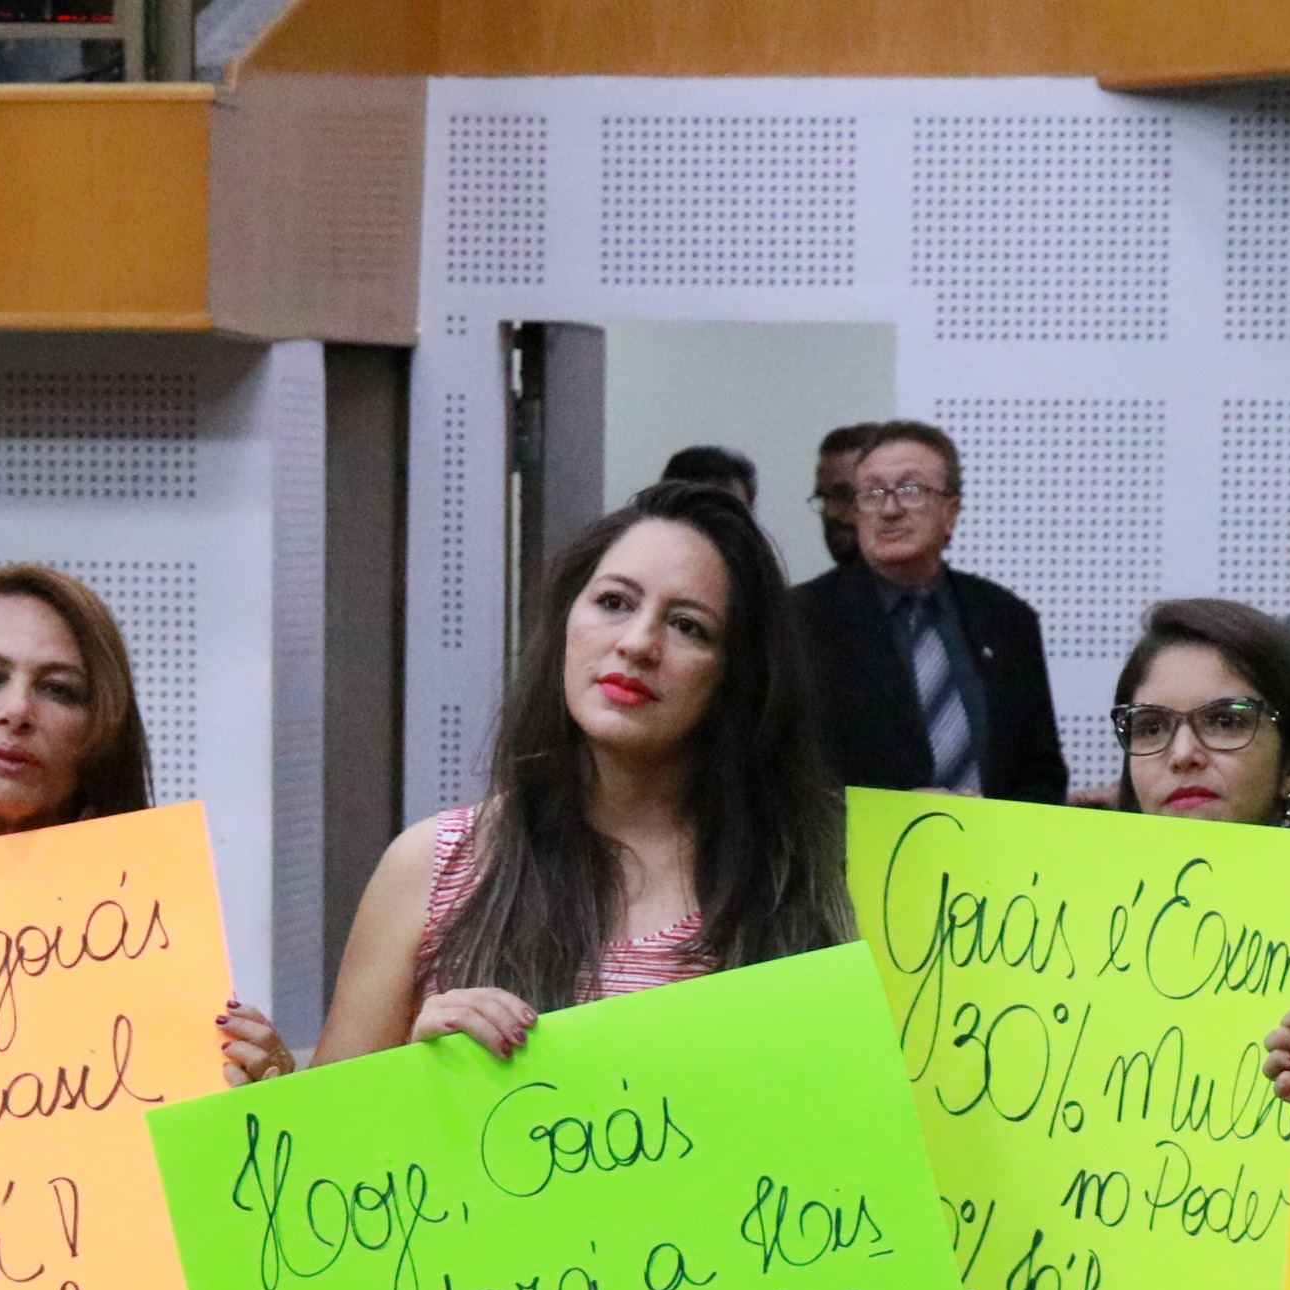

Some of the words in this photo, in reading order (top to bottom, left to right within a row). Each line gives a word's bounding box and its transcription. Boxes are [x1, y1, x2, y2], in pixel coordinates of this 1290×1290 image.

[883, 812, 1076, 1082] Goiás
[1097, 879, 1144, 978] é
[935, 1002, 1091, 1138] 30%
[481, 1078, 694, 1197] Goiás
[1061, 1169, 1130, 1227] no
